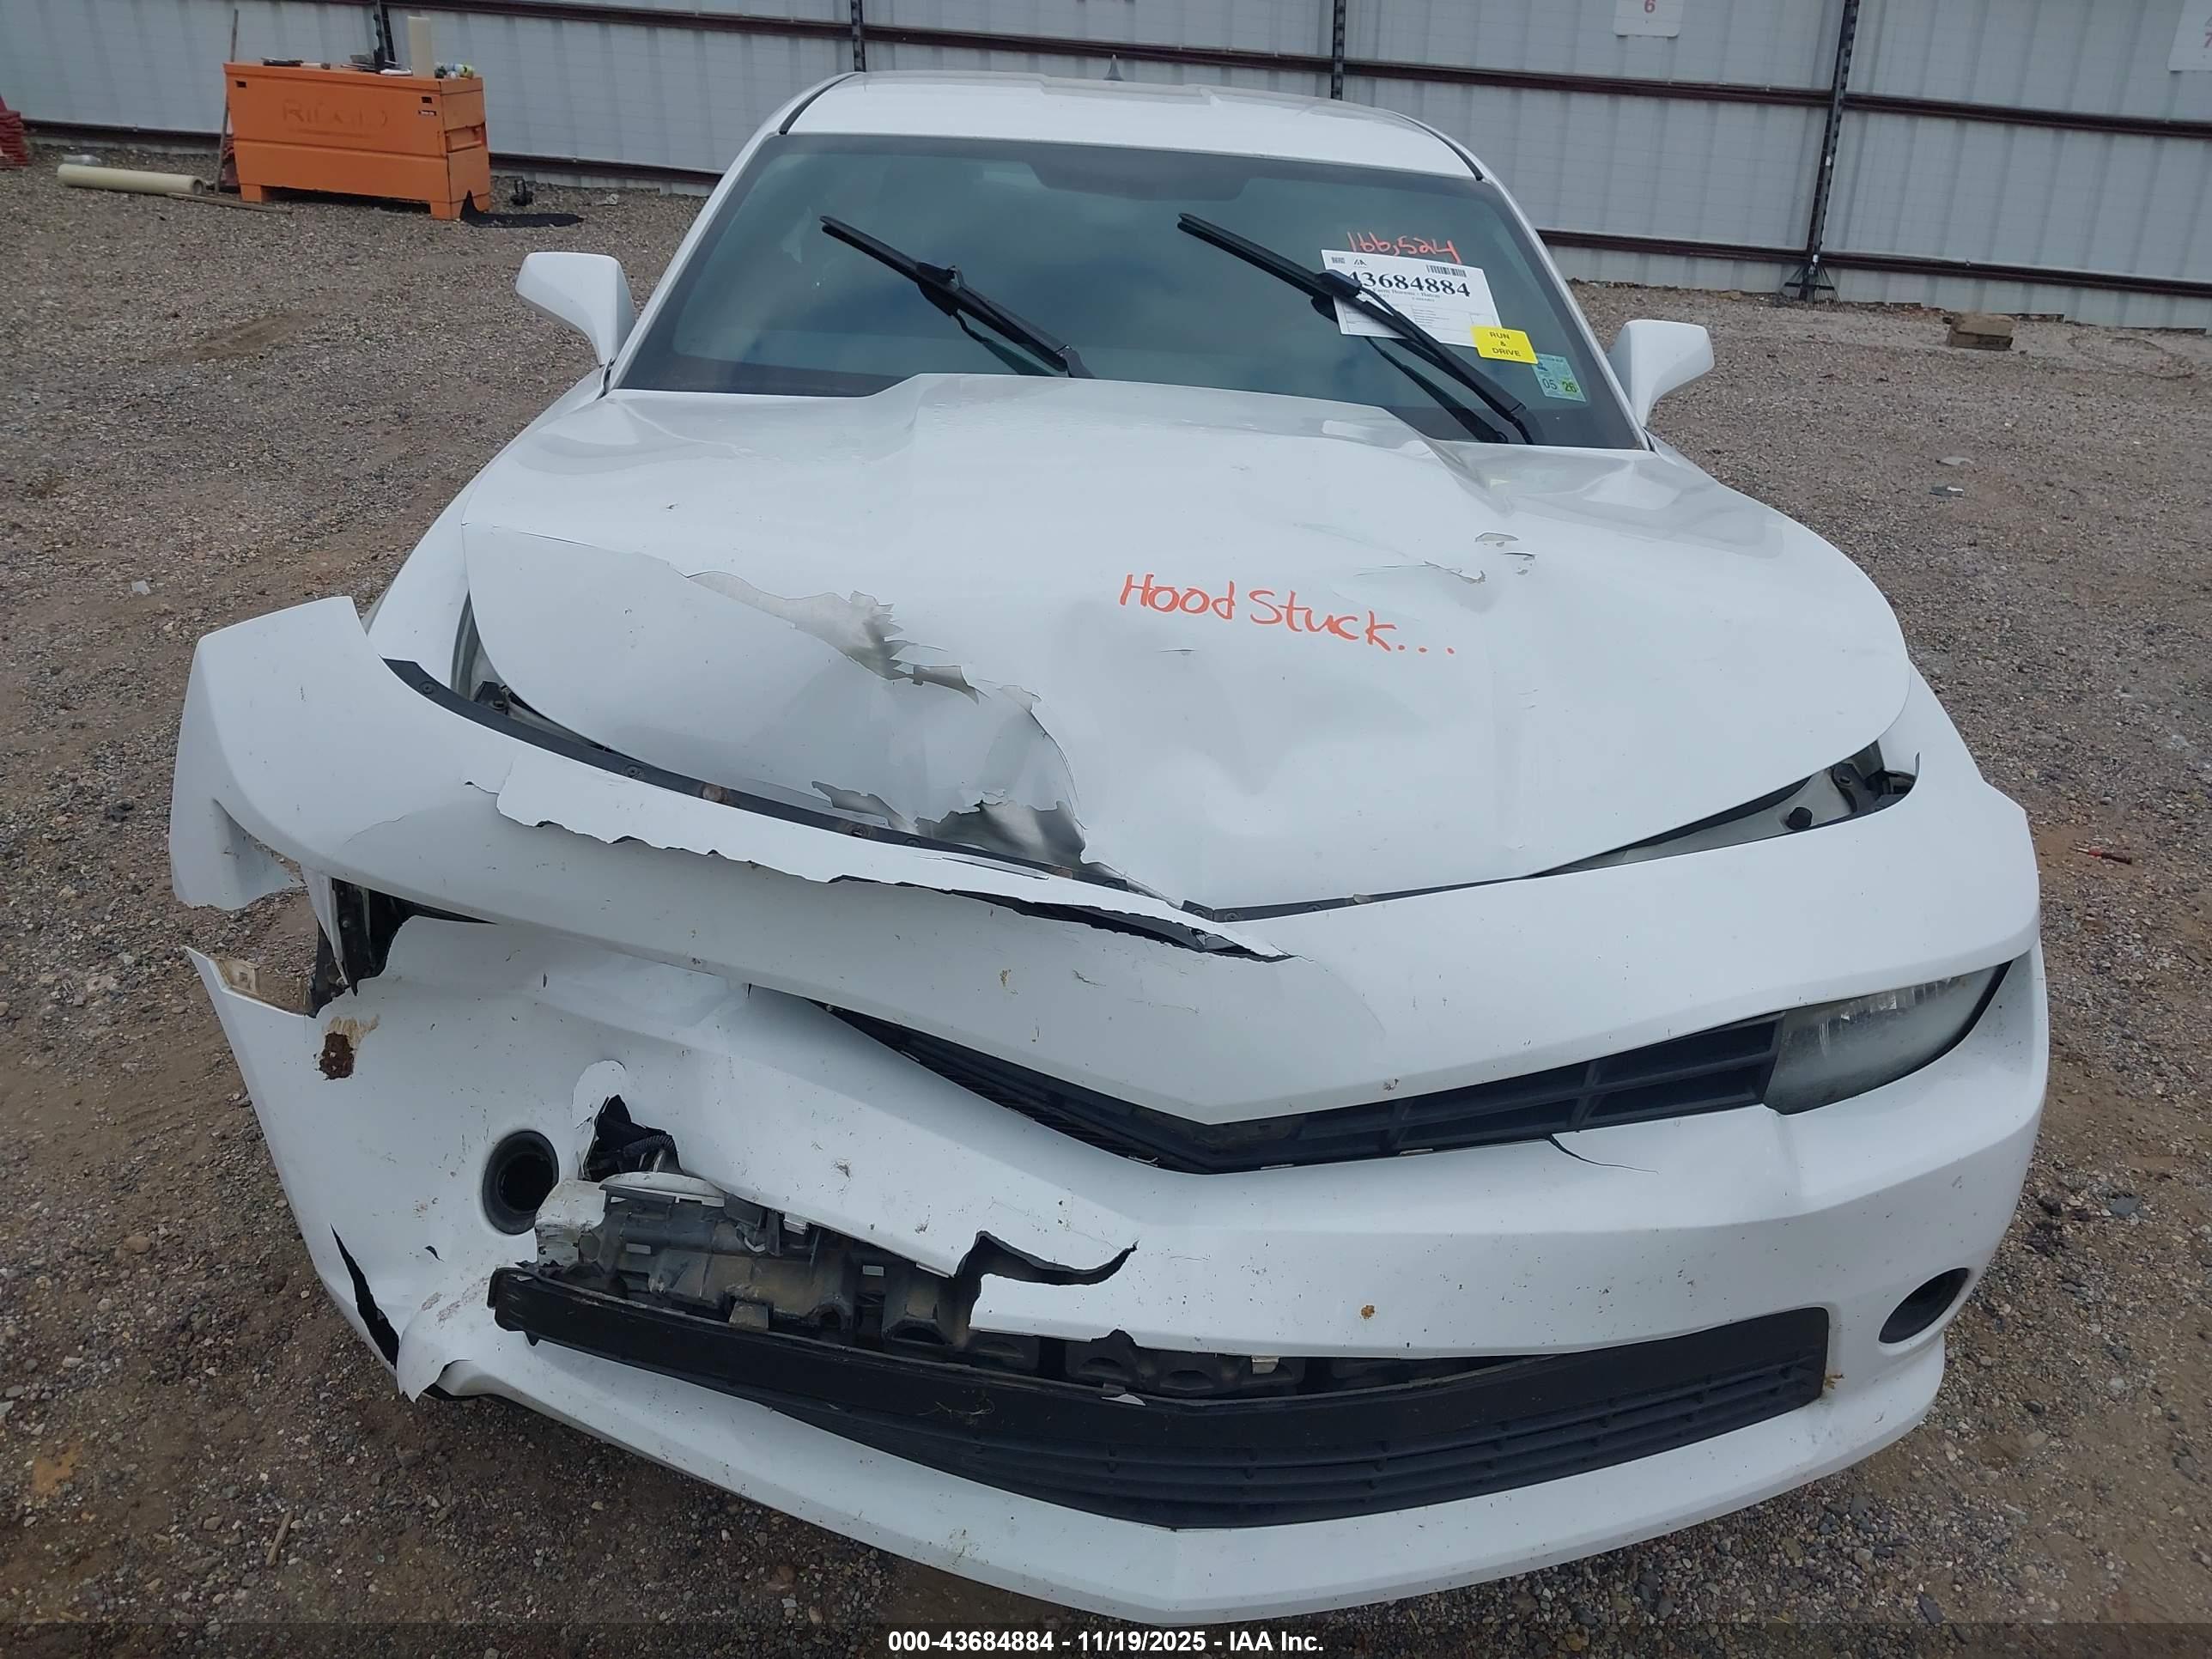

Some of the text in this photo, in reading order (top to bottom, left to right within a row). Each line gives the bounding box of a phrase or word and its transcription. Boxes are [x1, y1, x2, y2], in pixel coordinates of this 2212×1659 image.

[1644, 0, 1656, 13] 6
[1492, 348, 1521, 356] DRIVE
[1542, 378, 1577, 392] 05 26
[1119, 573, 1237, 621] Hood
